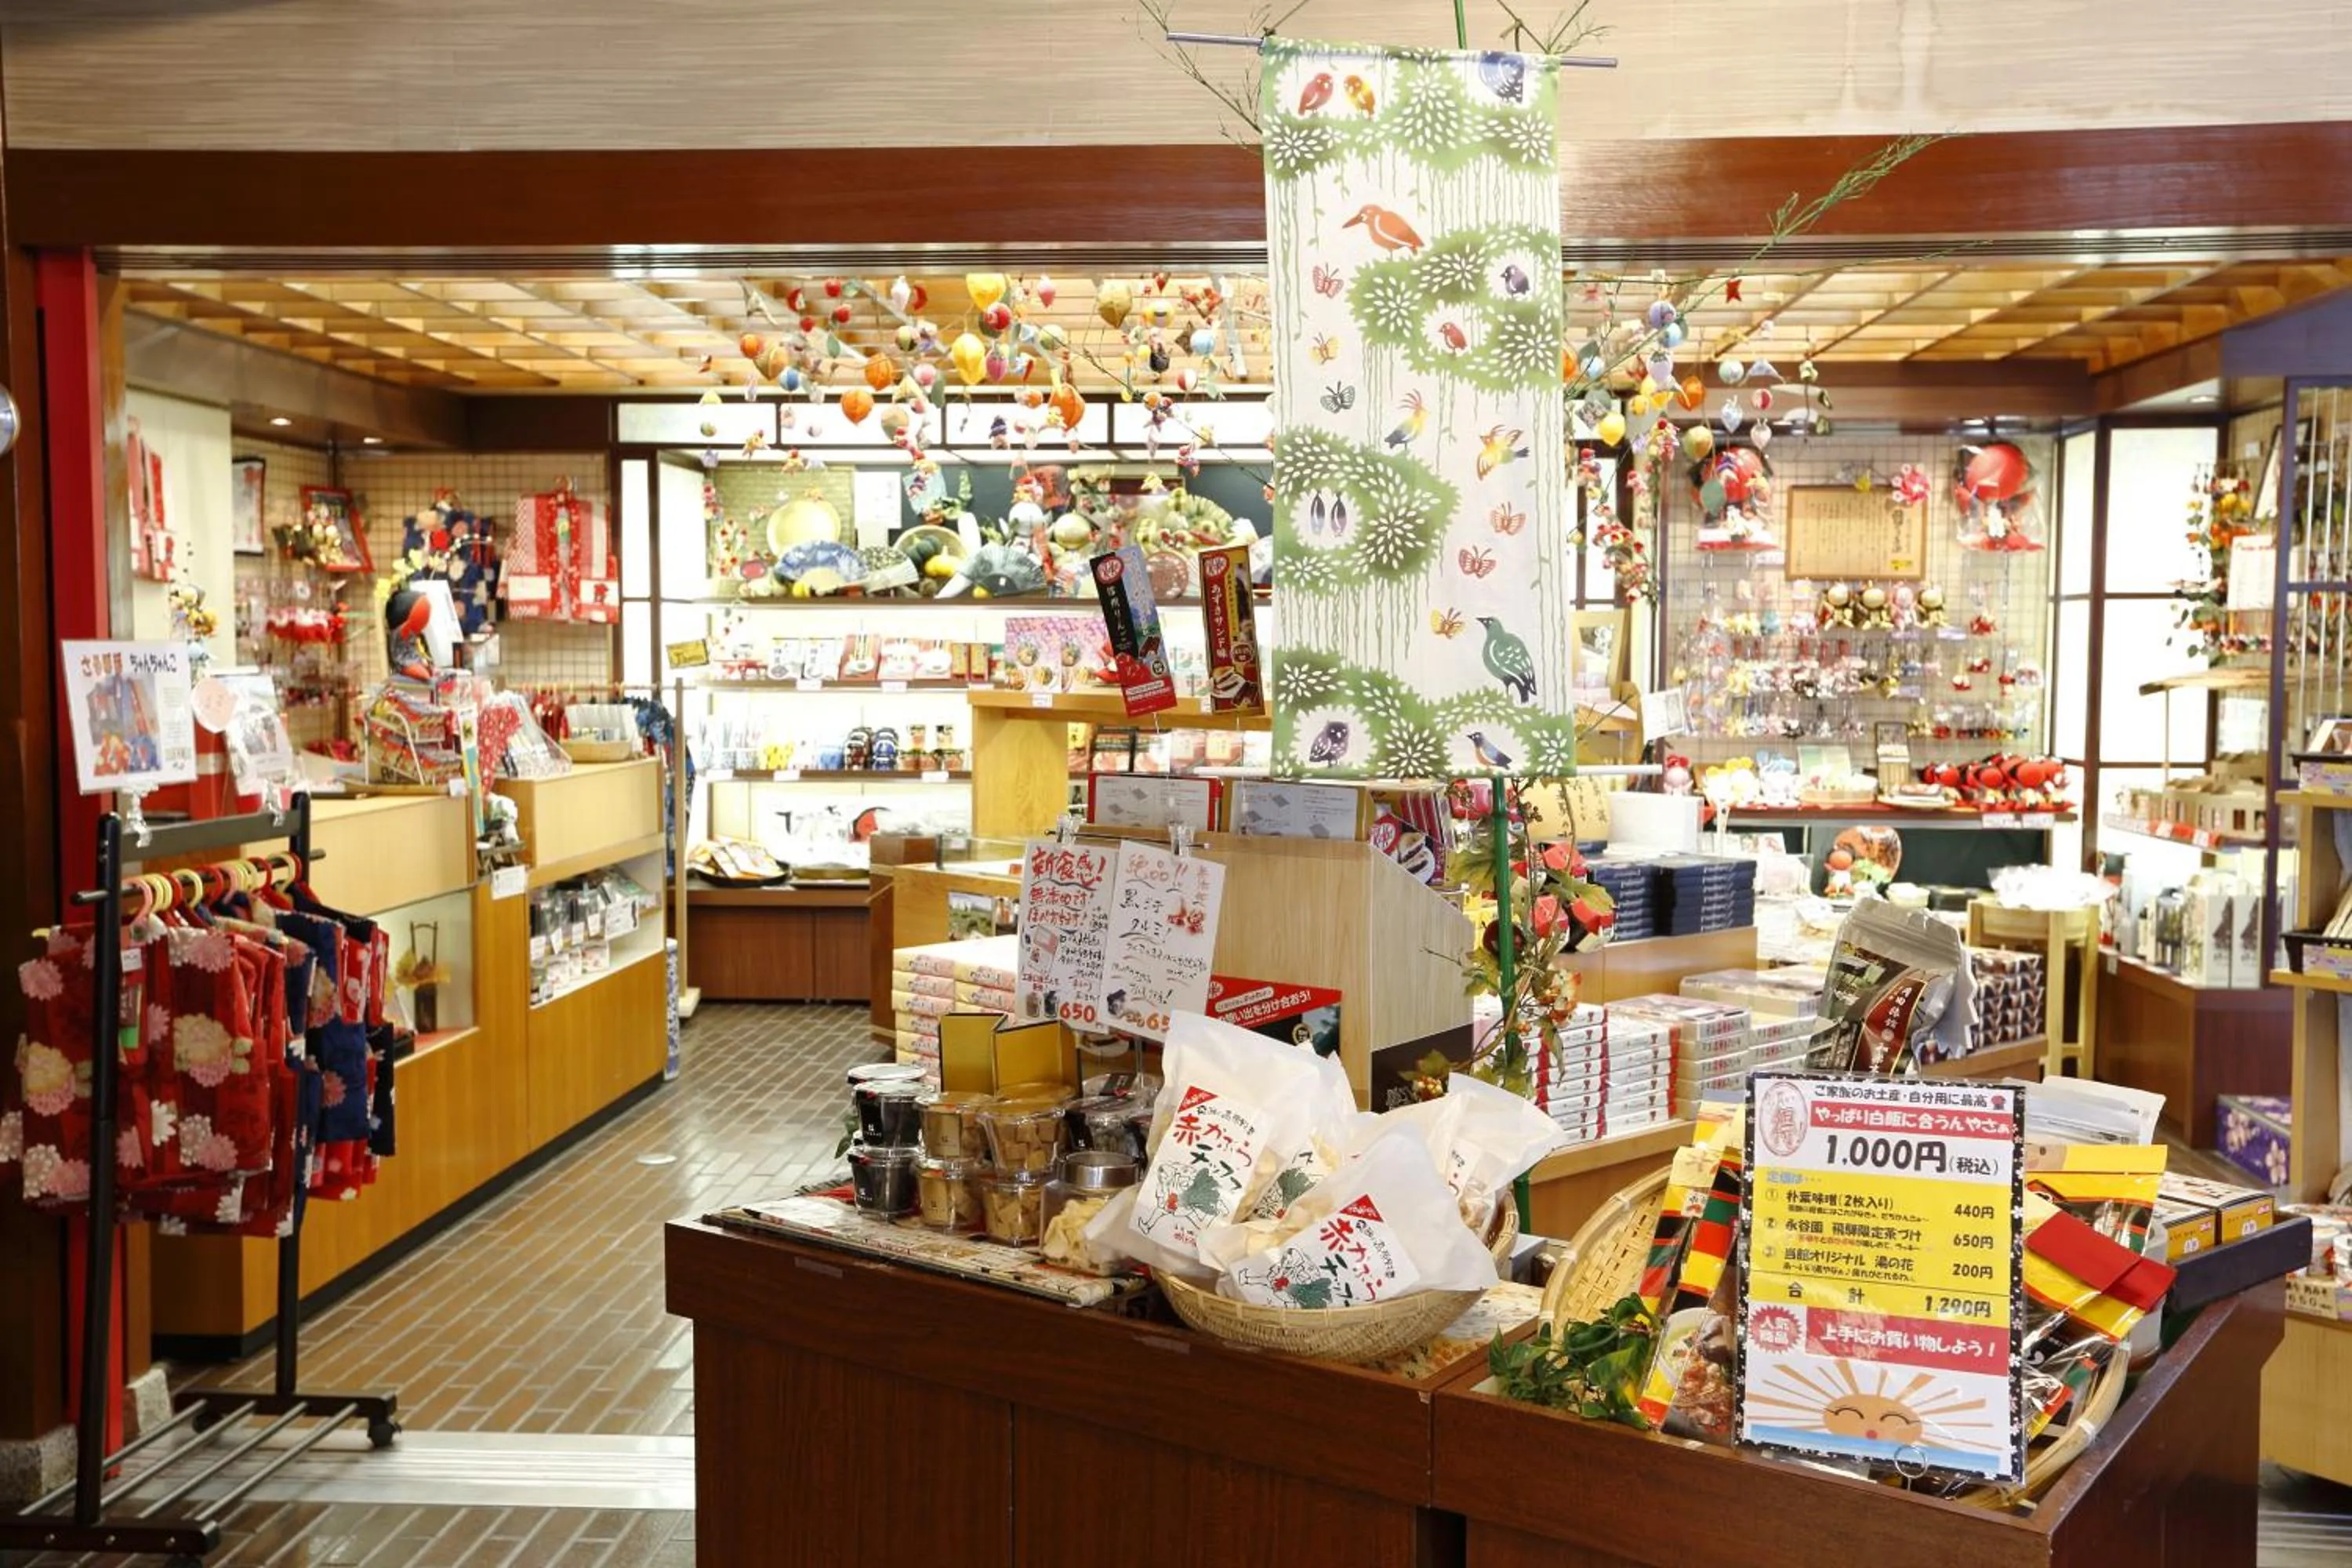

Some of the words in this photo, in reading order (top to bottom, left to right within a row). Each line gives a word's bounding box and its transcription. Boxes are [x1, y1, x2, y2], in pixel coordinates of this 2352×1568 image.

[1060, 1001, 1096, 1023] 650
[1954, 1203, 1994, 1220] 440円
[1784, 1218, 1824, 1234] 永谷園
[1953, 1233, 1994, 1250] 650円
[1784, 1247, 1866, 1268] 当館オリジナル
[1951, 1263, 1994, 1279] 200円
